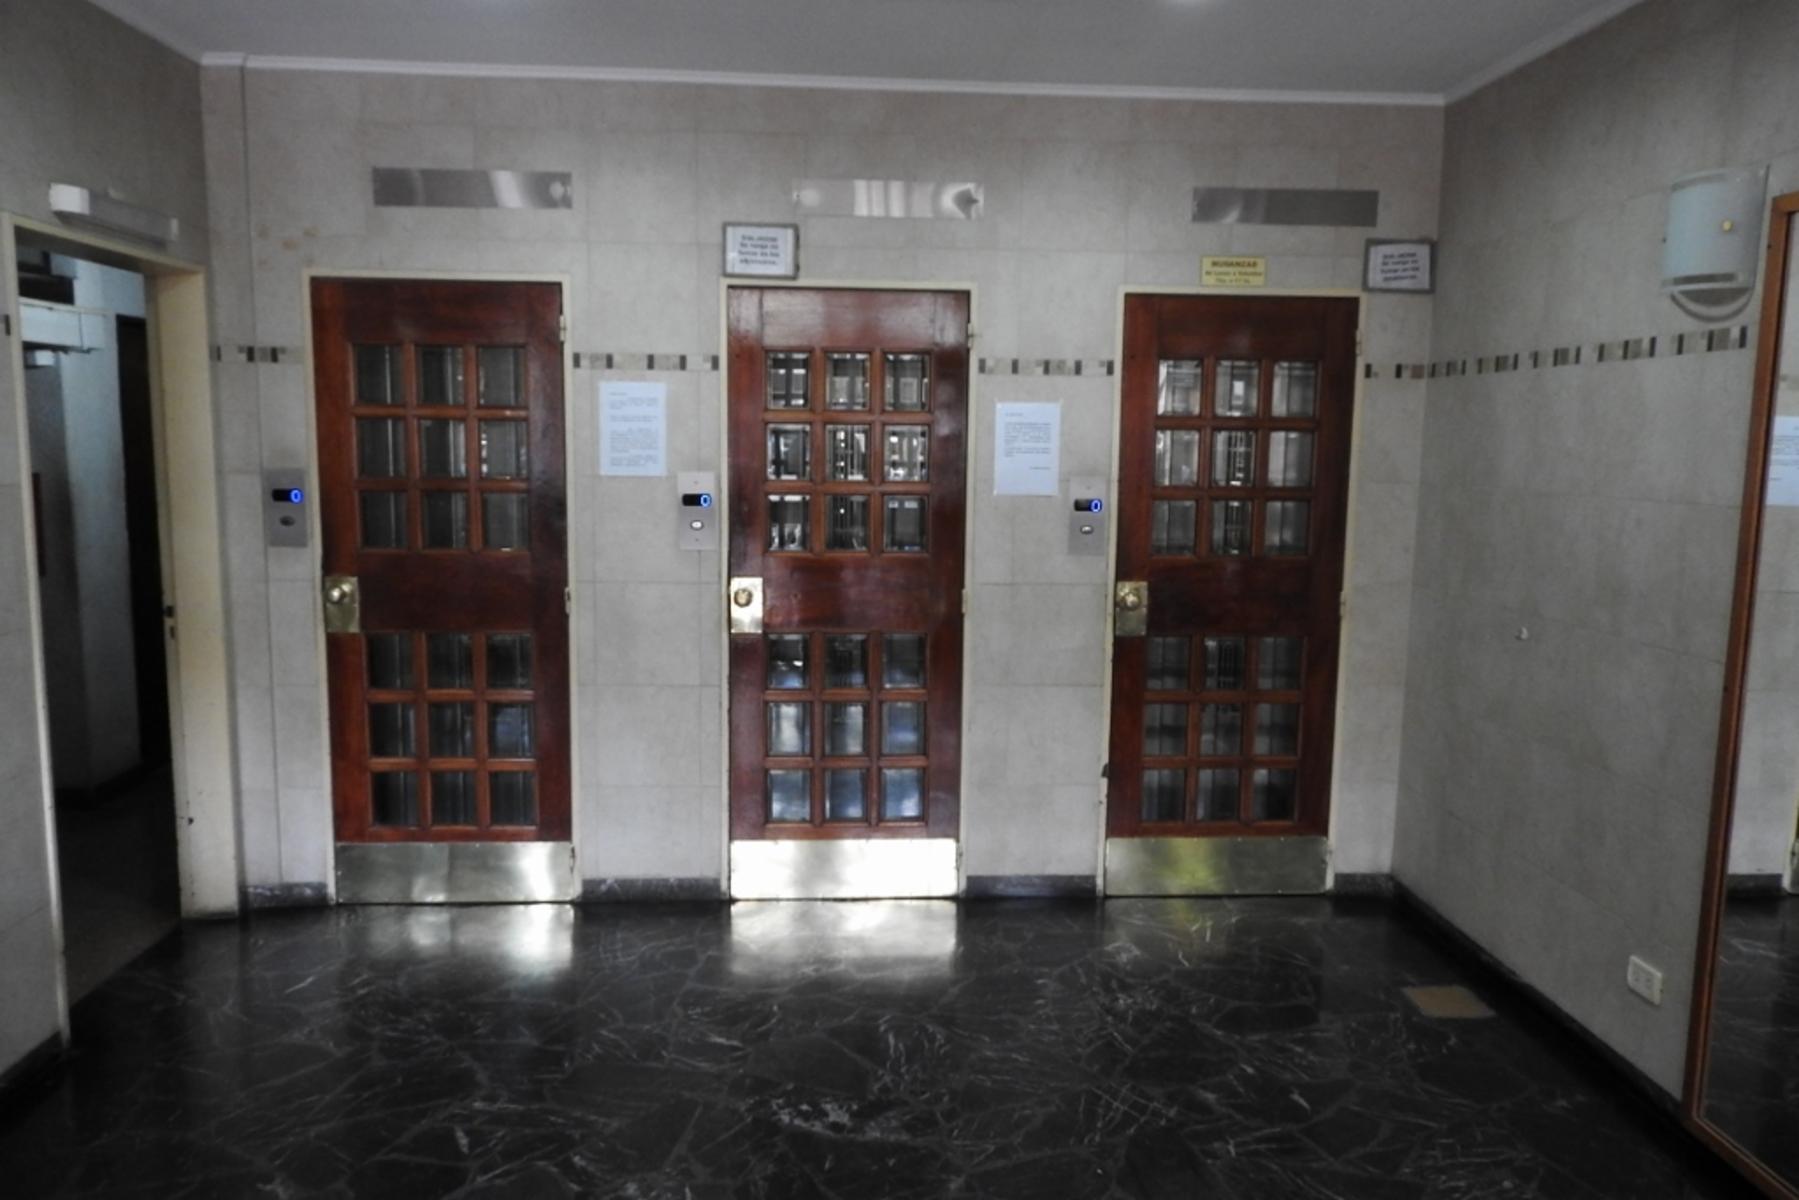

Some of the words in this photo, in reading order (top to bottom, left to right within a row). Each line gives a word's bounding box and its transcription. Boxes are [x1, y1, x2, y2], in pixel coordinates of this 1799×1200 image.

[291, 489, 301, 503] 0
[700, 494, 711, 508] 0
[1091, 499, 1101, 512] 0
